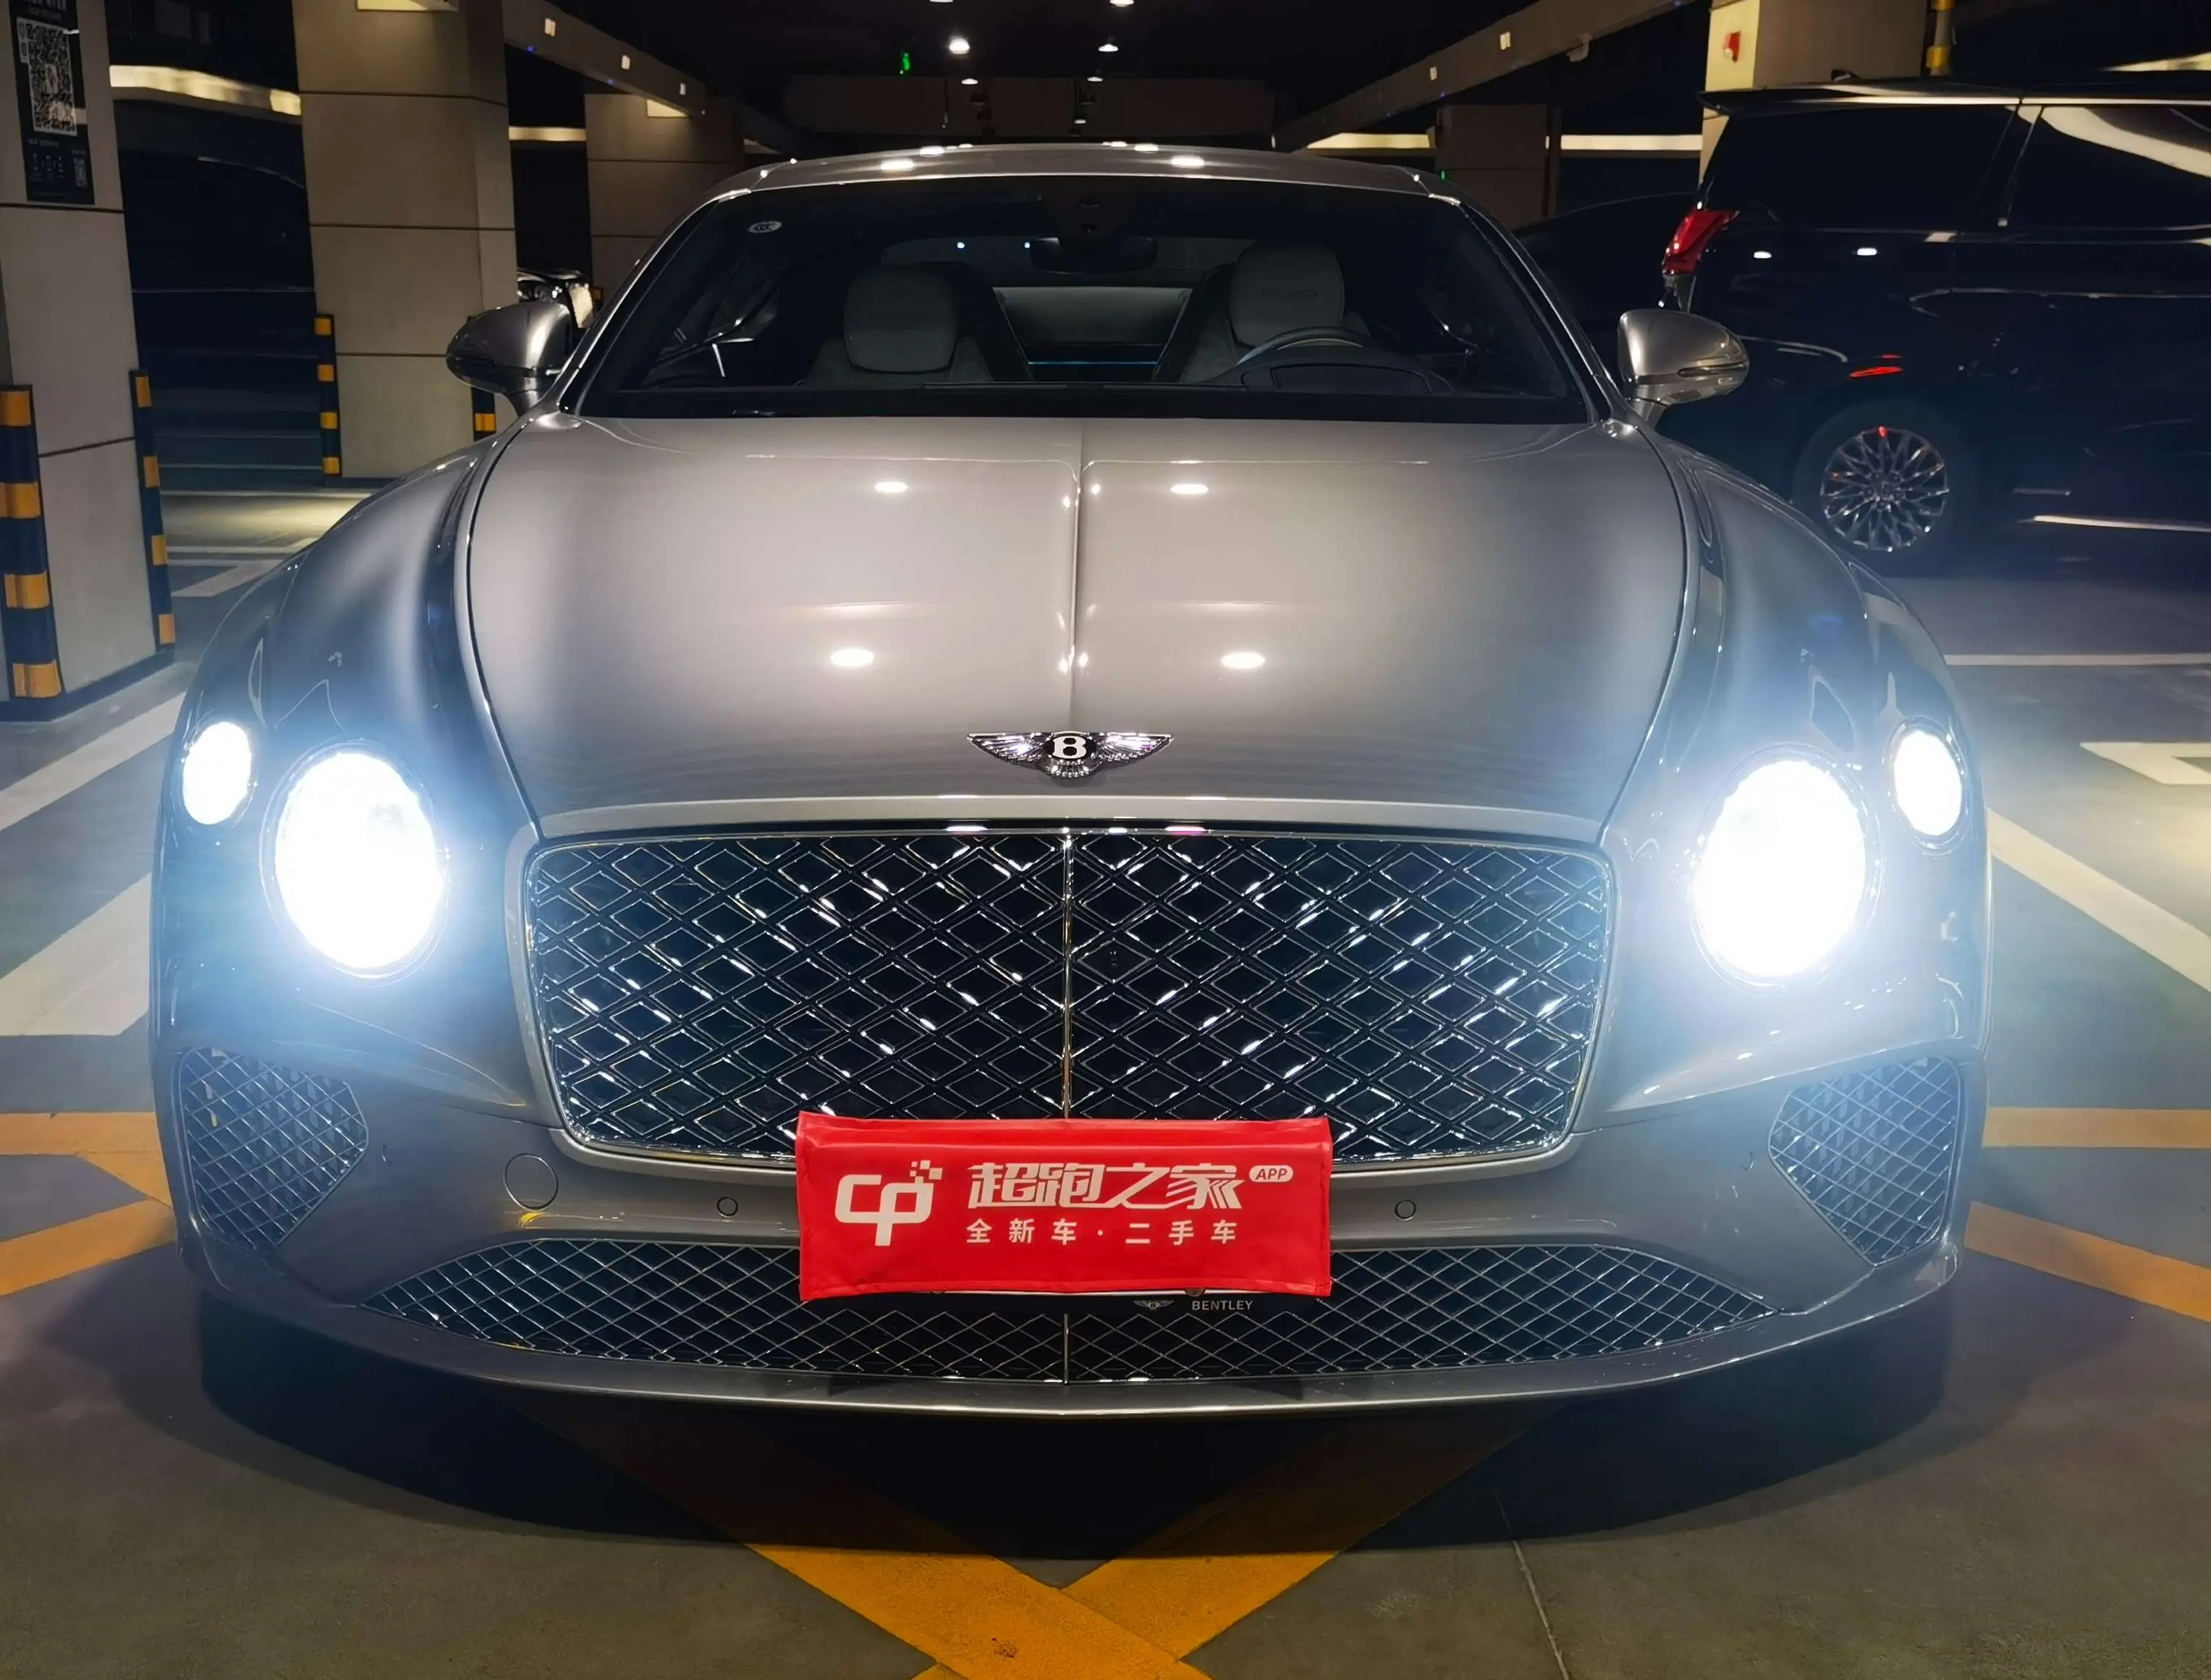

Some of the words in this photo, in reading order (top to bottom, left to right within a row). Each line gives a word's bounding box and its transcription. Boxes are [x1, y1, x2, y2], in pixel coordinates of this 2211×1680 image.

[1052, 735, 1087, 759] B
[1255, 1168, 1288, 1181] APP
[968, 1162, 1244, 1210] 超跑之家
[1192, 1300, 1254, 1311] BENTLEY
